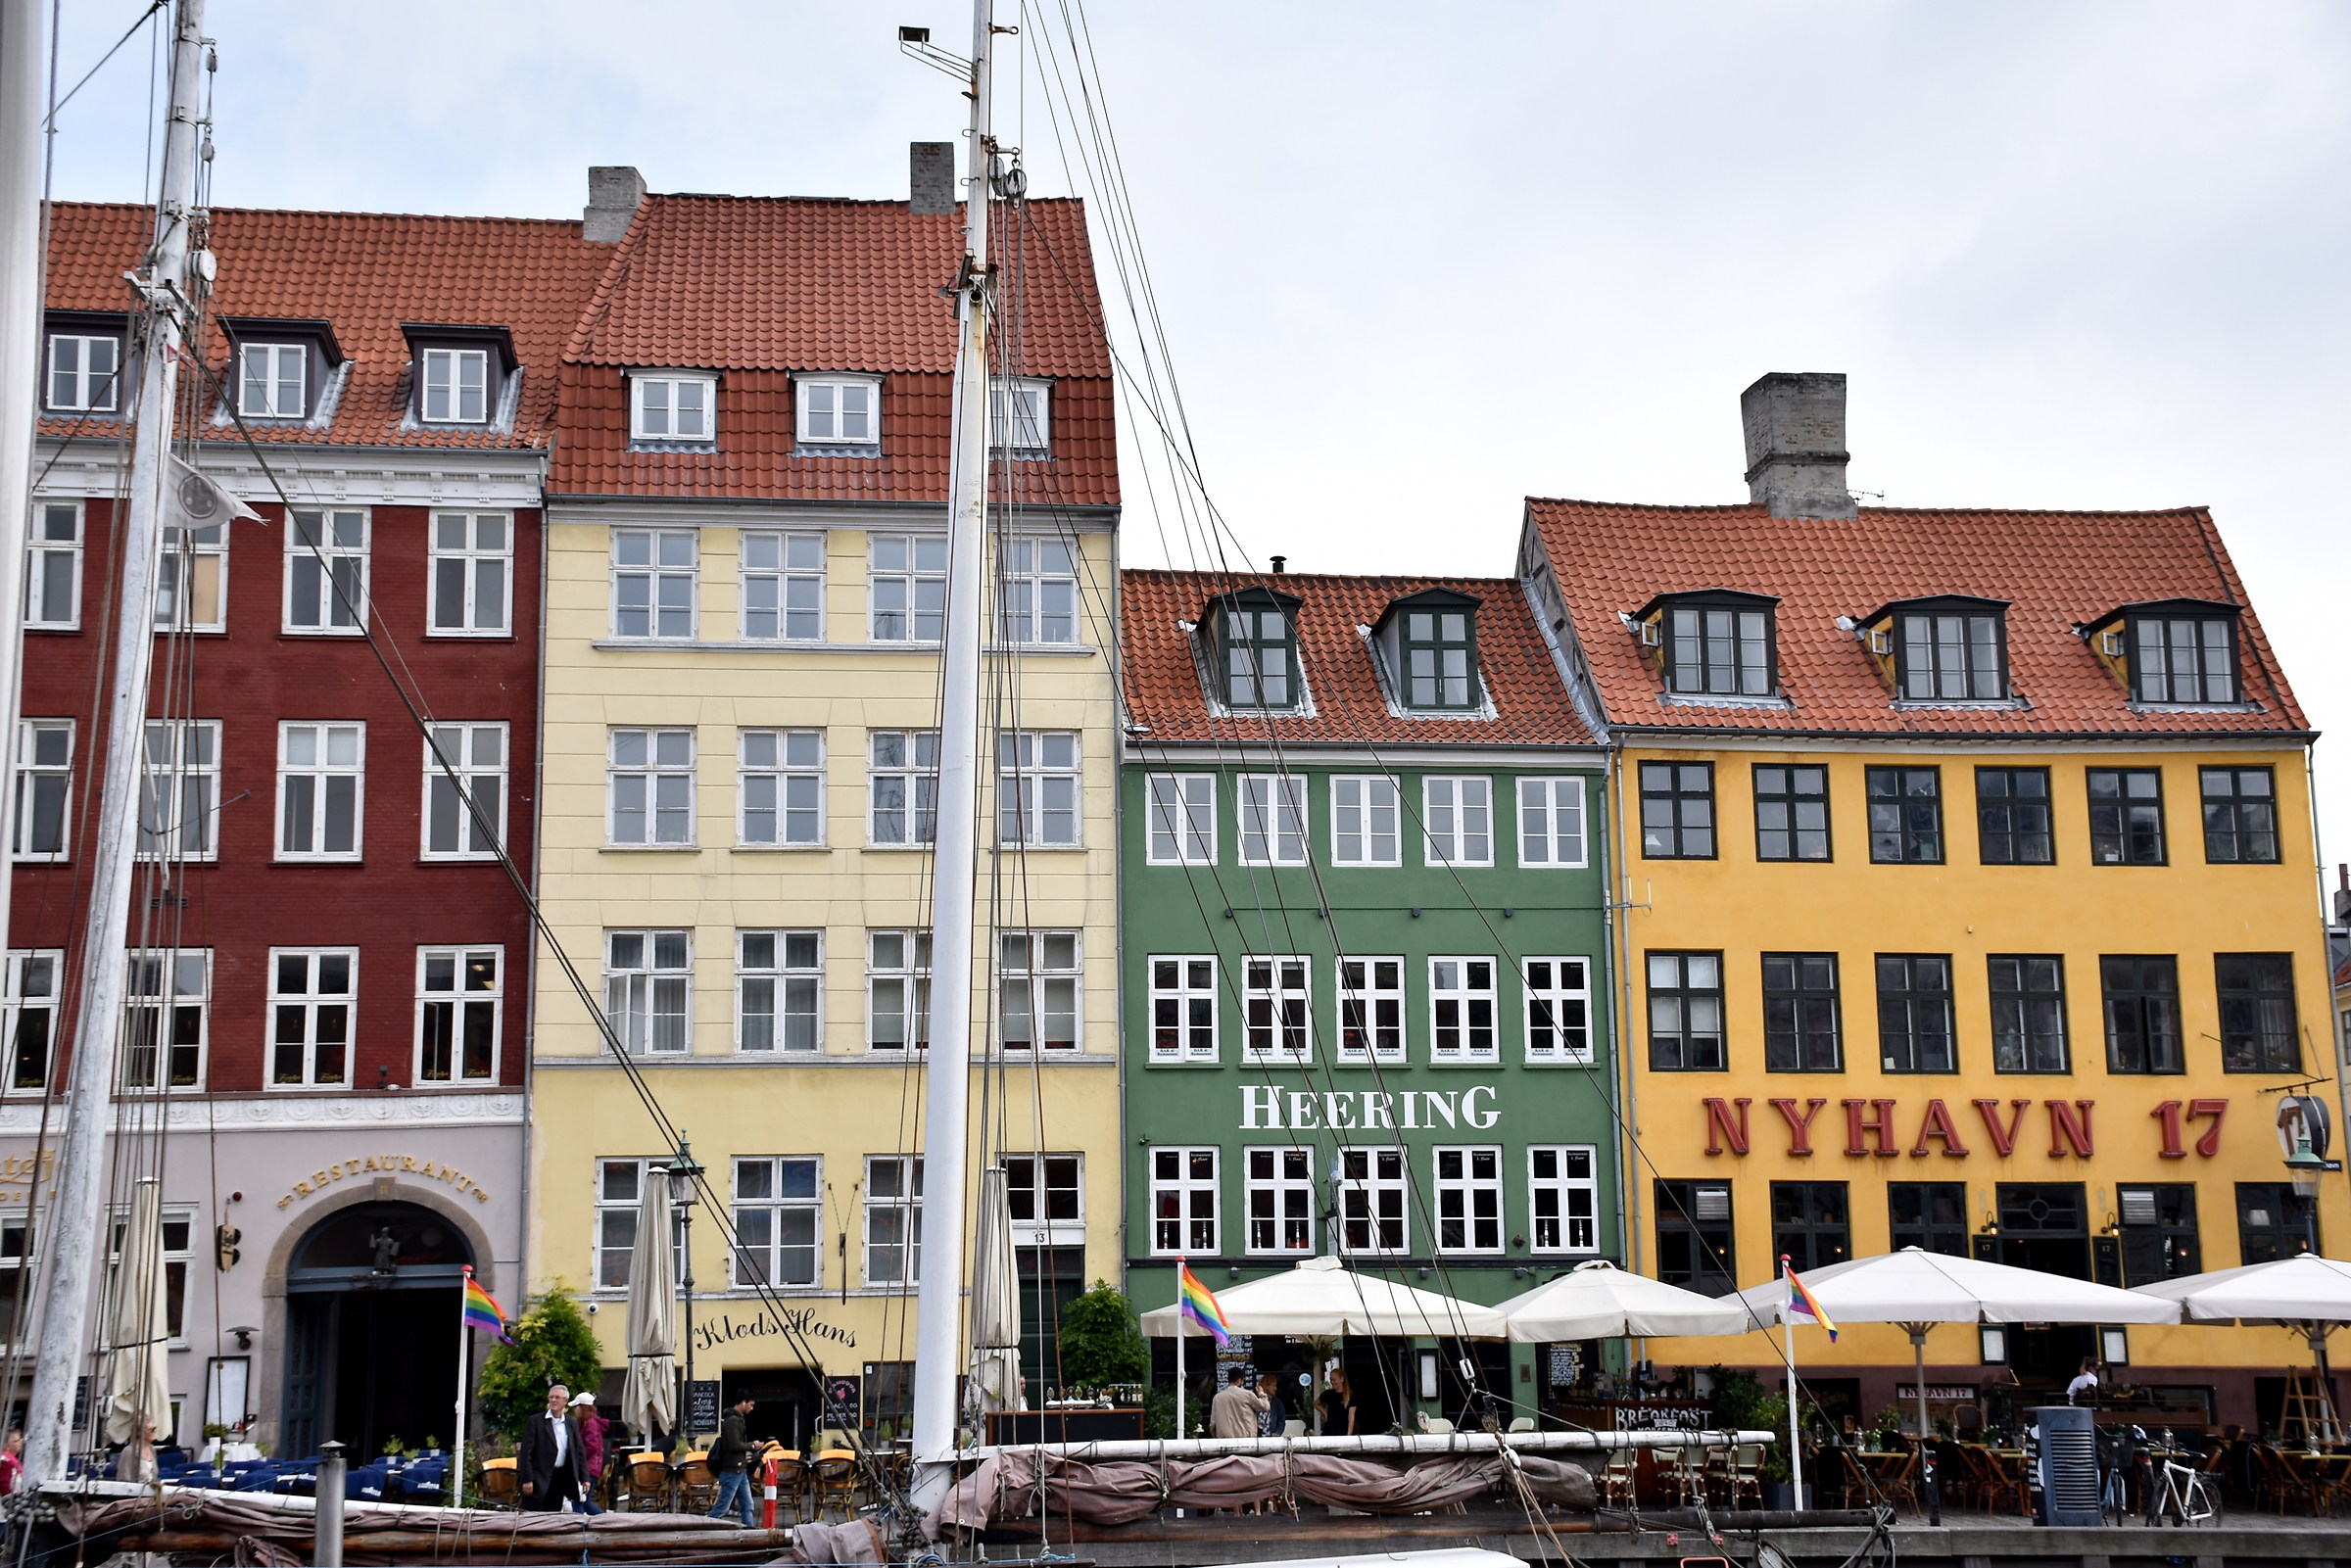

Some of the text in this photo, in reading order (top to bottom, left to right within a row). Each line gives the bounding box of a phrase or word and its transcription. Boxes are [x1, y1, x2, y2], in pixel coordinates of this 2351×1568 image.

[1238, 1085, 1502, 1129] HEERING
[1702, 1097, 2230, 1159] NYHAVN 17
[293, 1155, 475, 1199] RESTAURANT
[693, 1307, 857, 1351] Klods Hans
